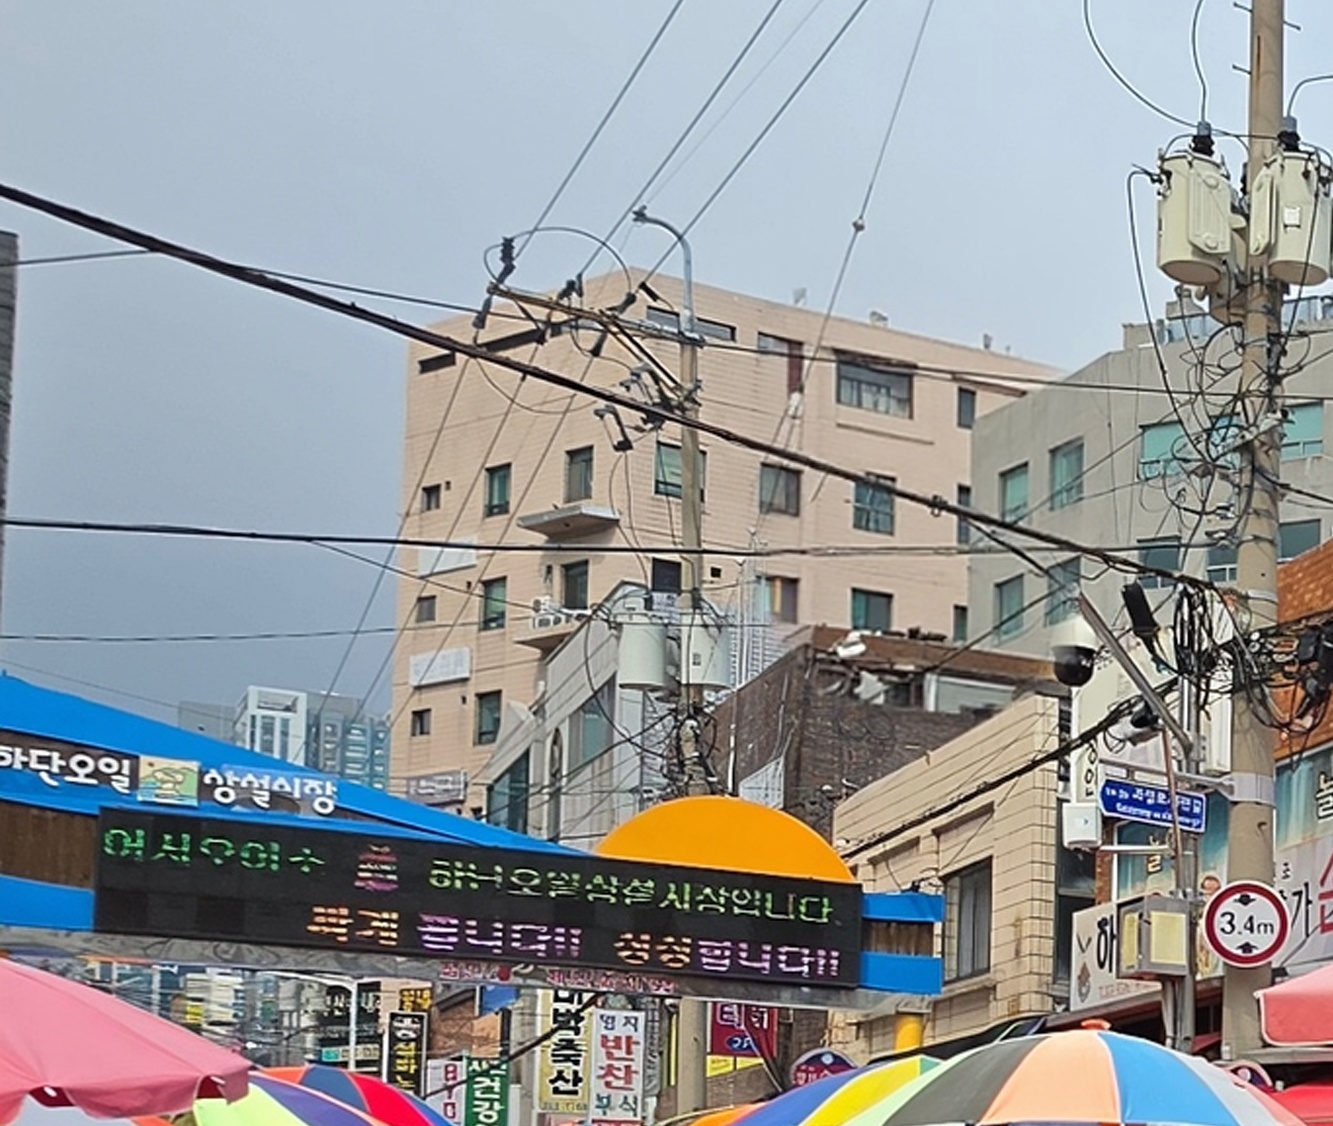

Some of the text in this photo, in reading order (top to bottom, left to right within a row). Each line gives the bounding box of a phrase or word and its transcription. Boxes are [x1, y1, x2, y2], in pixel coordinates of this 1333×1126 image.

[0, 745, 338, 815] 하단오일 상설시장
[1219, 911, 1275, 936] 3.4m
[599, 1013, 639, 1033] 명지
[596, 1034, 641, 1092] 반찬
